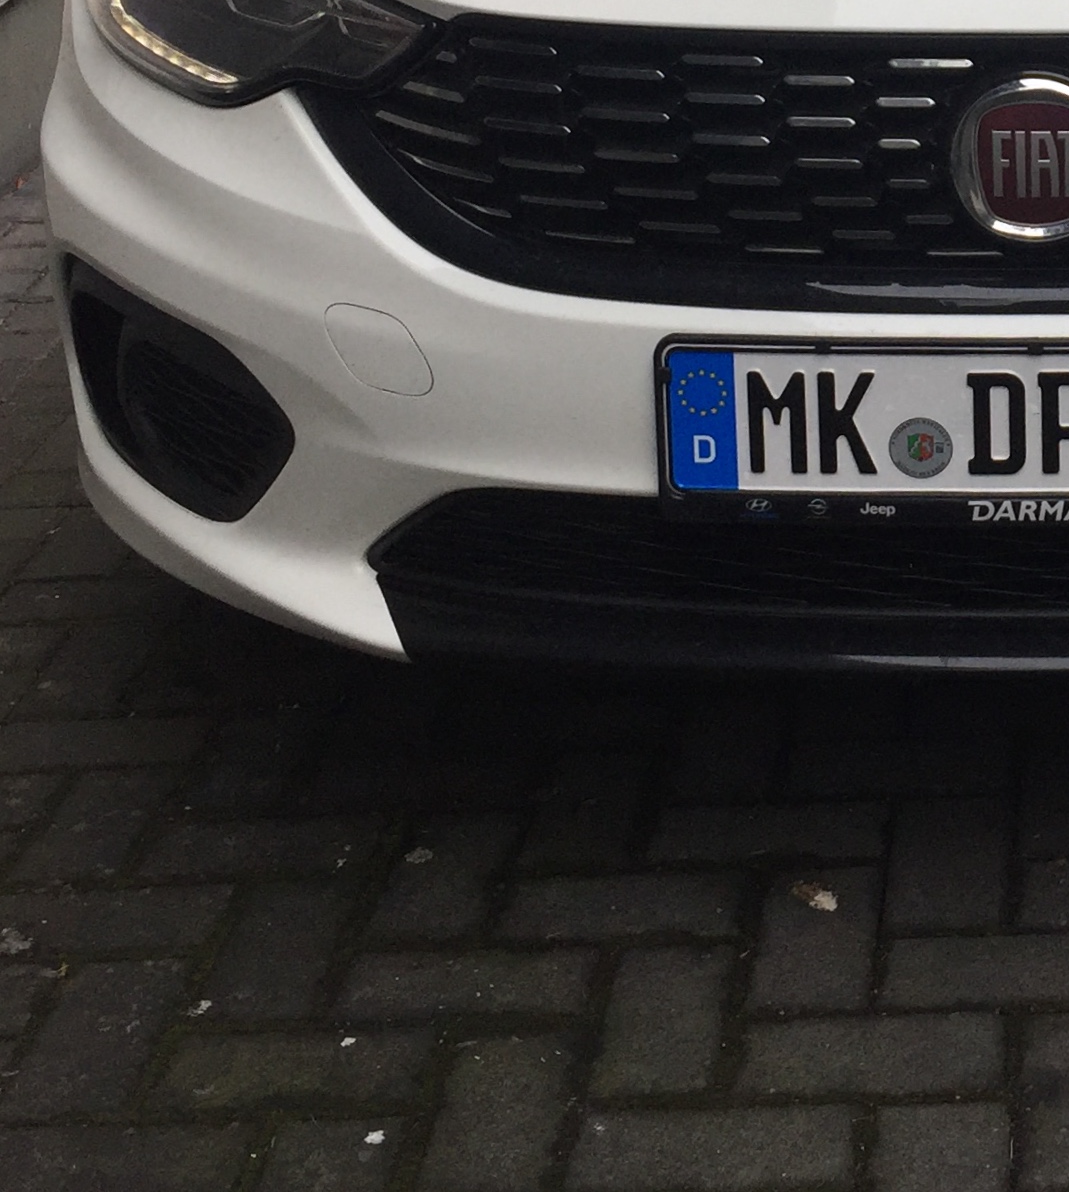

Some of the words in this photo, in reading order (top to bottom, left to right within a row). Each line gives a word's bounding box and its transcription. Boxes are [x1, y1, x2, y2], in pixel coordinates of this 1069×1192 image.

[746, 370, 877, 474] MK
[693, 435, 717, 463] D
[860, 502, 896, 517] Jeep
